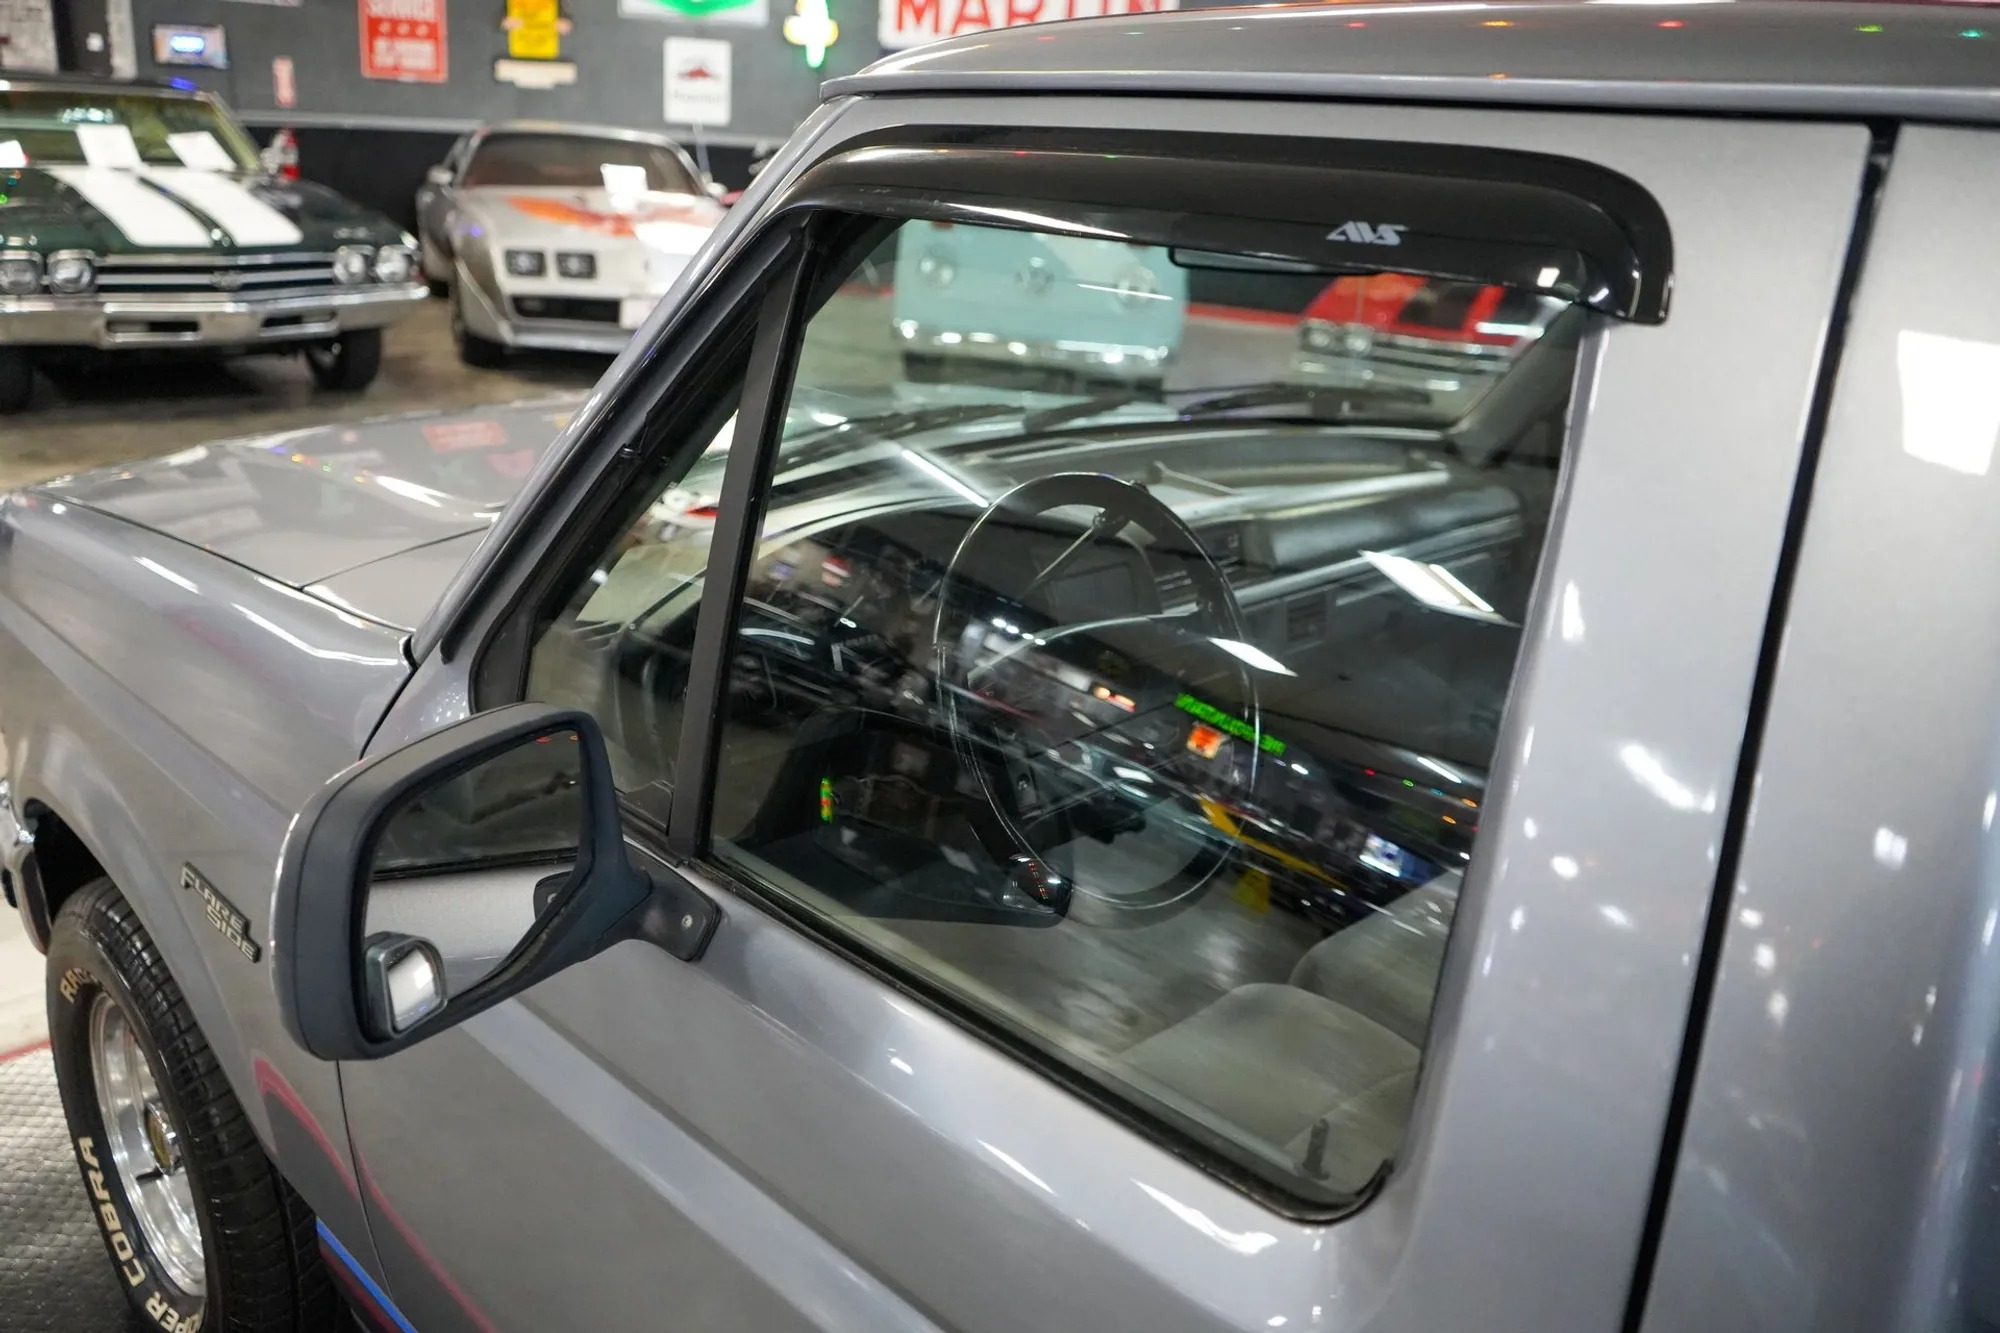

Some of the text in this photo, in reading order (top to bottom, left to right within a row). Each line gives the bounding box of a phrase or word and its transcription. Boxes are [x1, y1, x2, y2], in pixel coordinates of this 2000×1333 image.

[896, 0, 1163, 34] MAR
[1324, 221, 1410, 246] AVS
[180, 865, 243, 935] FLARE
[206, 903, 255, 961] SIDE
[78, 1136, 146, 1287] COBRA
